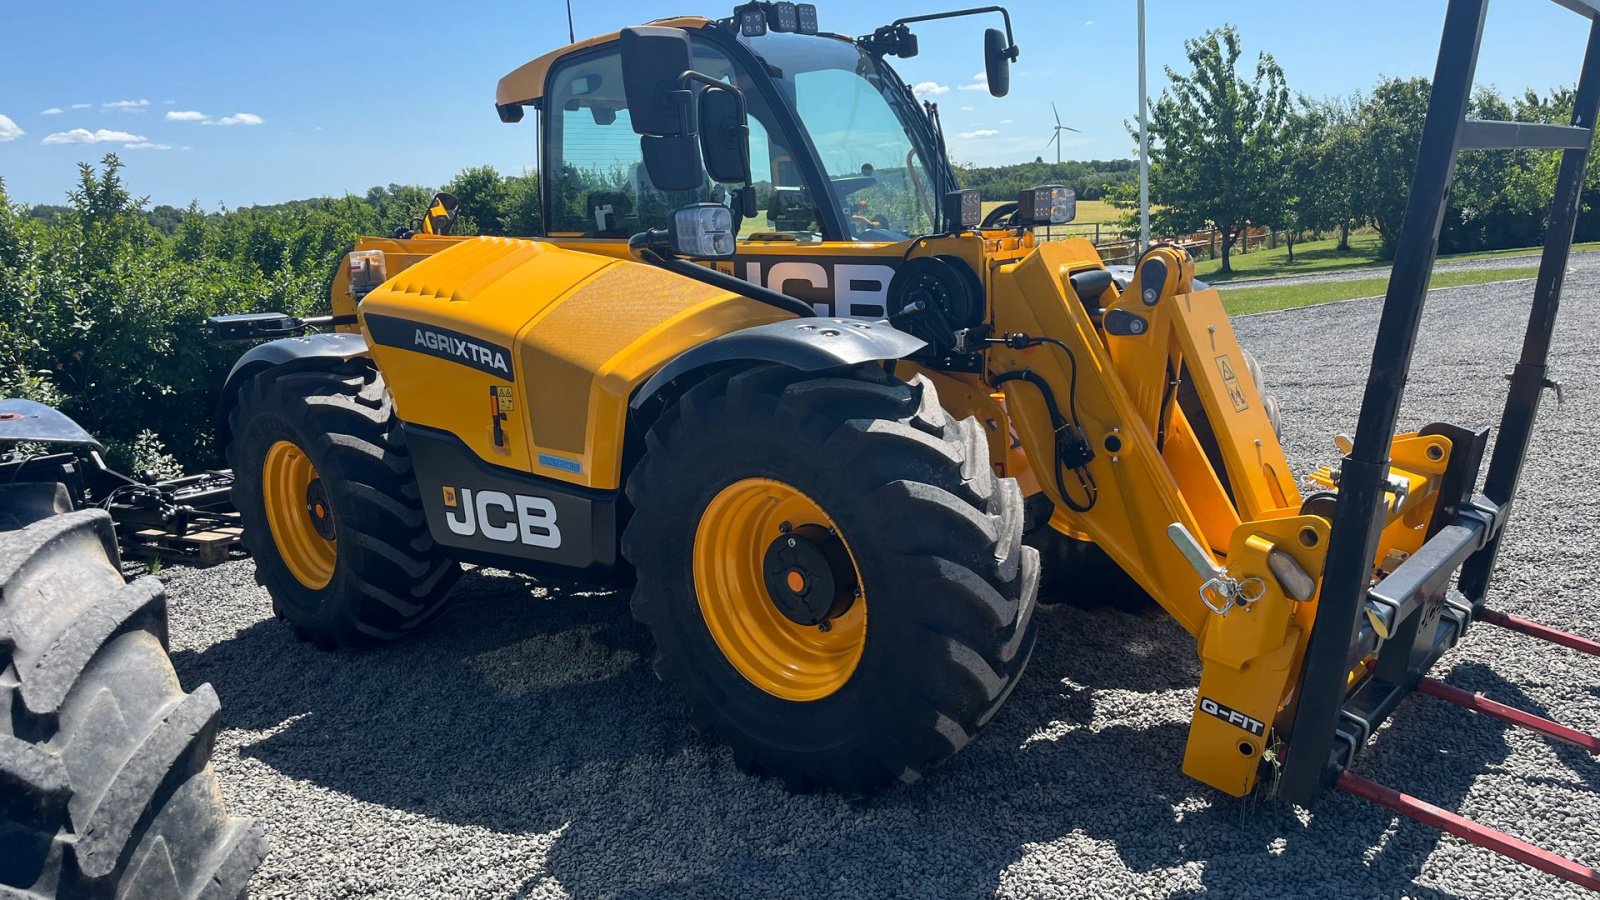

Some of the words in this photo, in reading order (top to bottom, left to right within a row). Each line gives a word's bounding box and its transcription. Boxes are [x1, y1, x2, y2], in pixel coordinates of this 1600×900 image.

[414, 328, 508, 373] AGRIXTRA
[445, 488, 561, 549] JCB
[1201, 699, 1264, 733] Q-FIT
